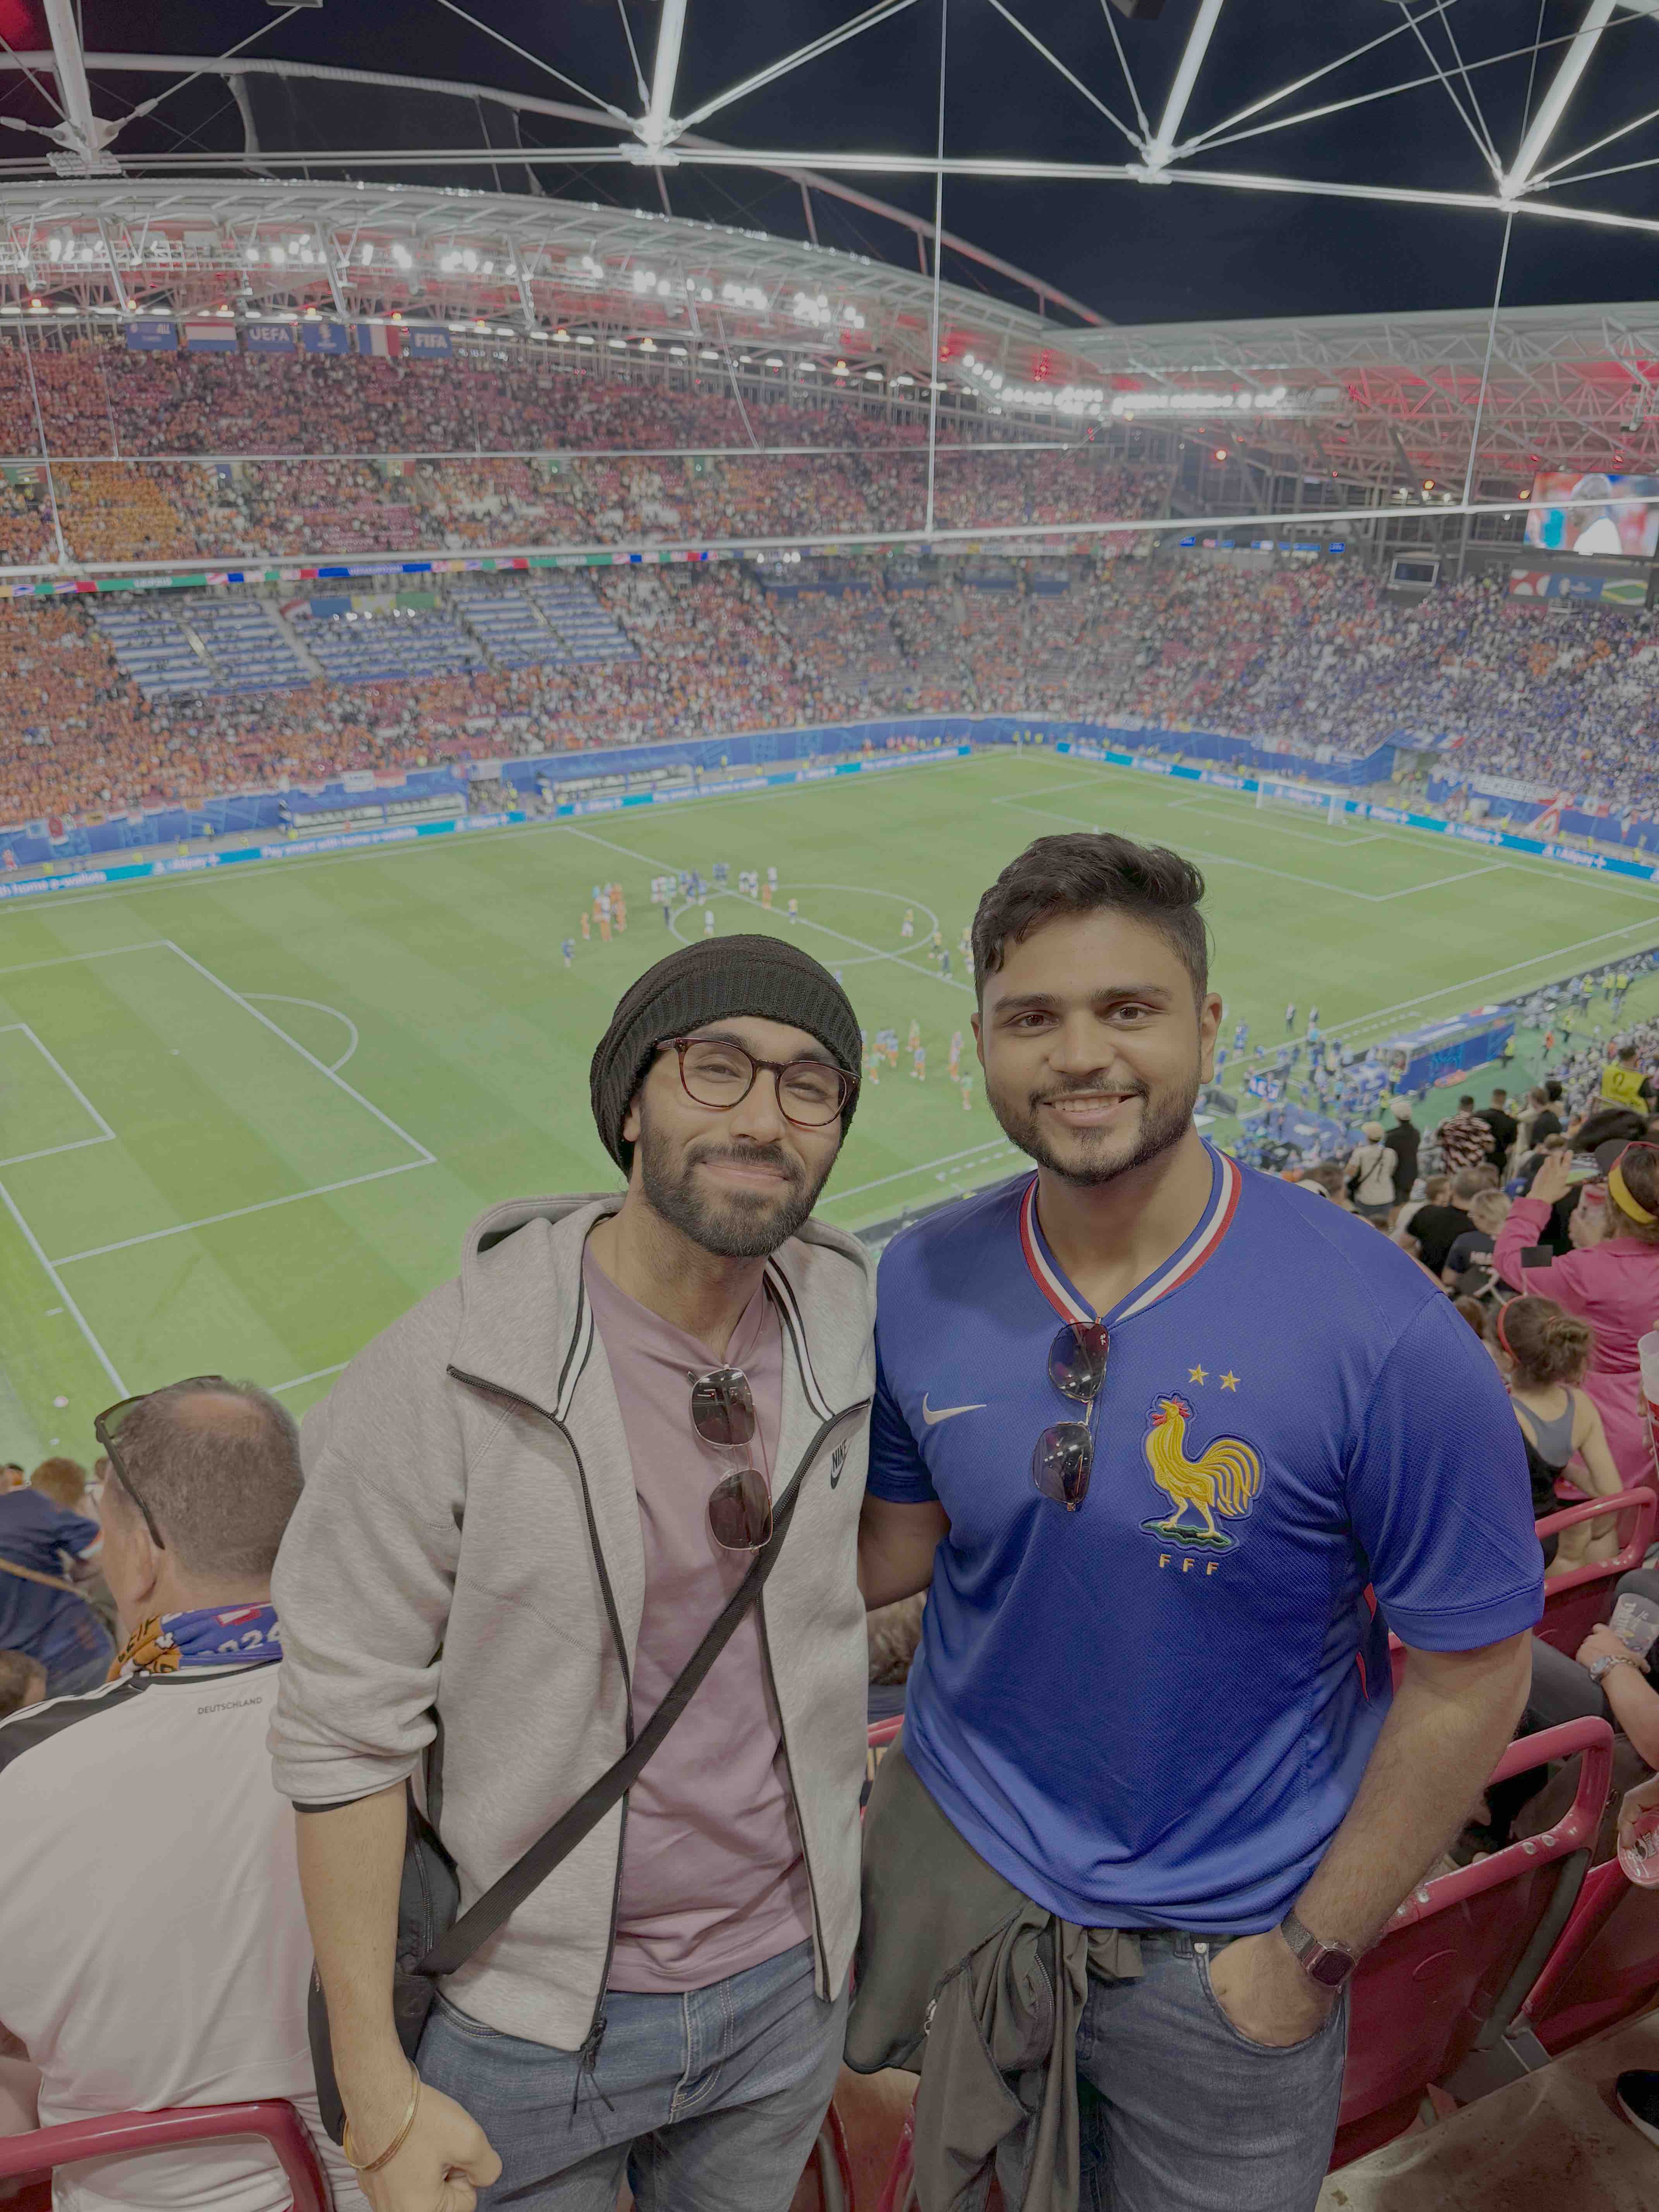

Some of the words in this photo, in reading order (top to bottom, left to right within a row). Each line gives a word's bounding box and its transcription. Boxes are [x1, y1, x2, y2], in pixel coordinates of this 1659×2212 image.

[249, 327, 290, 342] UEFA
[415, 333, 448, 348] FIFA
[832, 1438, 847, 1472] NIKE
[198, 1697, 263, 1715] DEUTSCHLAND
